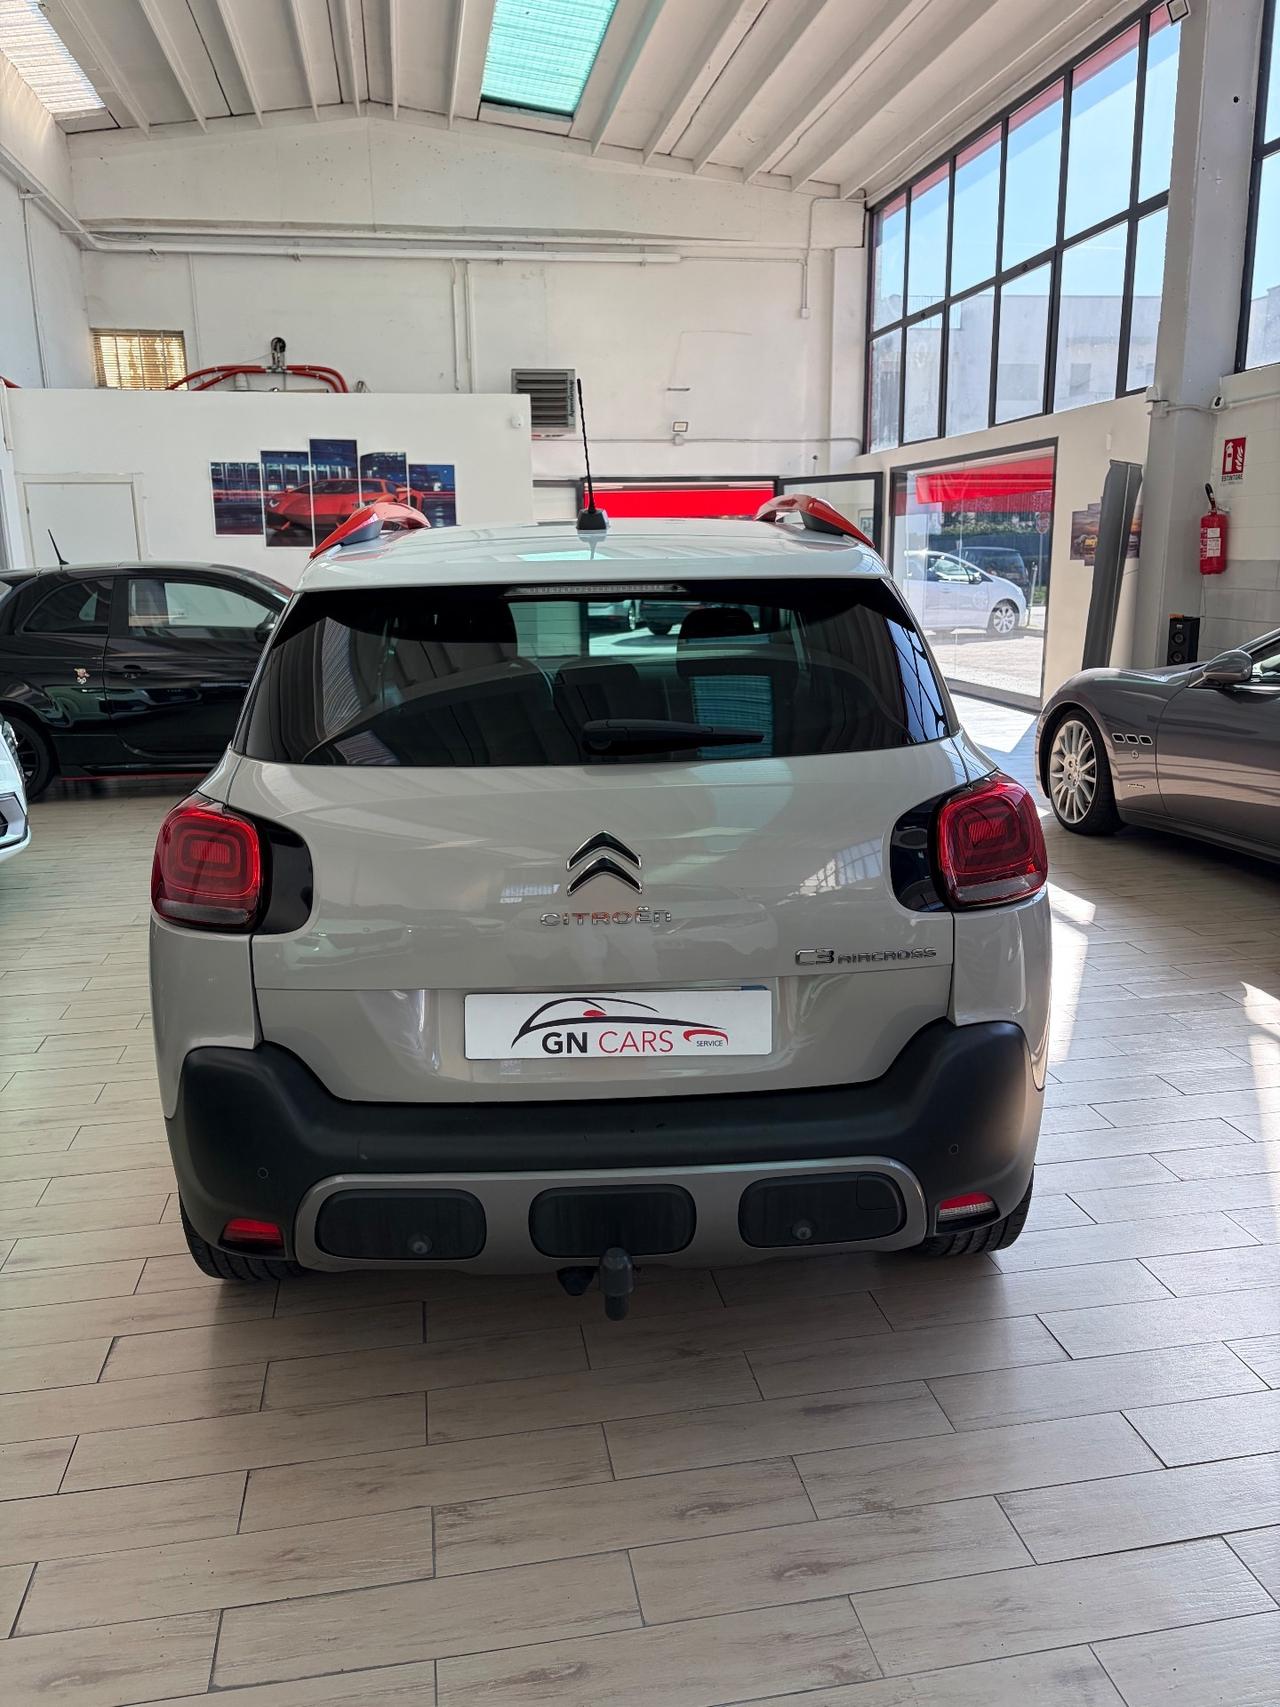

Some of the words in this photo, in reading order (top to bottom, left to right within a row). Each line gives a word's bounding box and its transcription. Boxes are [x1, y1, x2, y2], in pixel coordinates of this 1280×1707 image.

[540, 906, 671, 926] CITROËN
[795, 948, 834, 965] C3
[838, 947, 937, 964] AIRCROSS
[542, 1032, 587, 1054] GN
[599, 1030, 673, 1053] CARS
